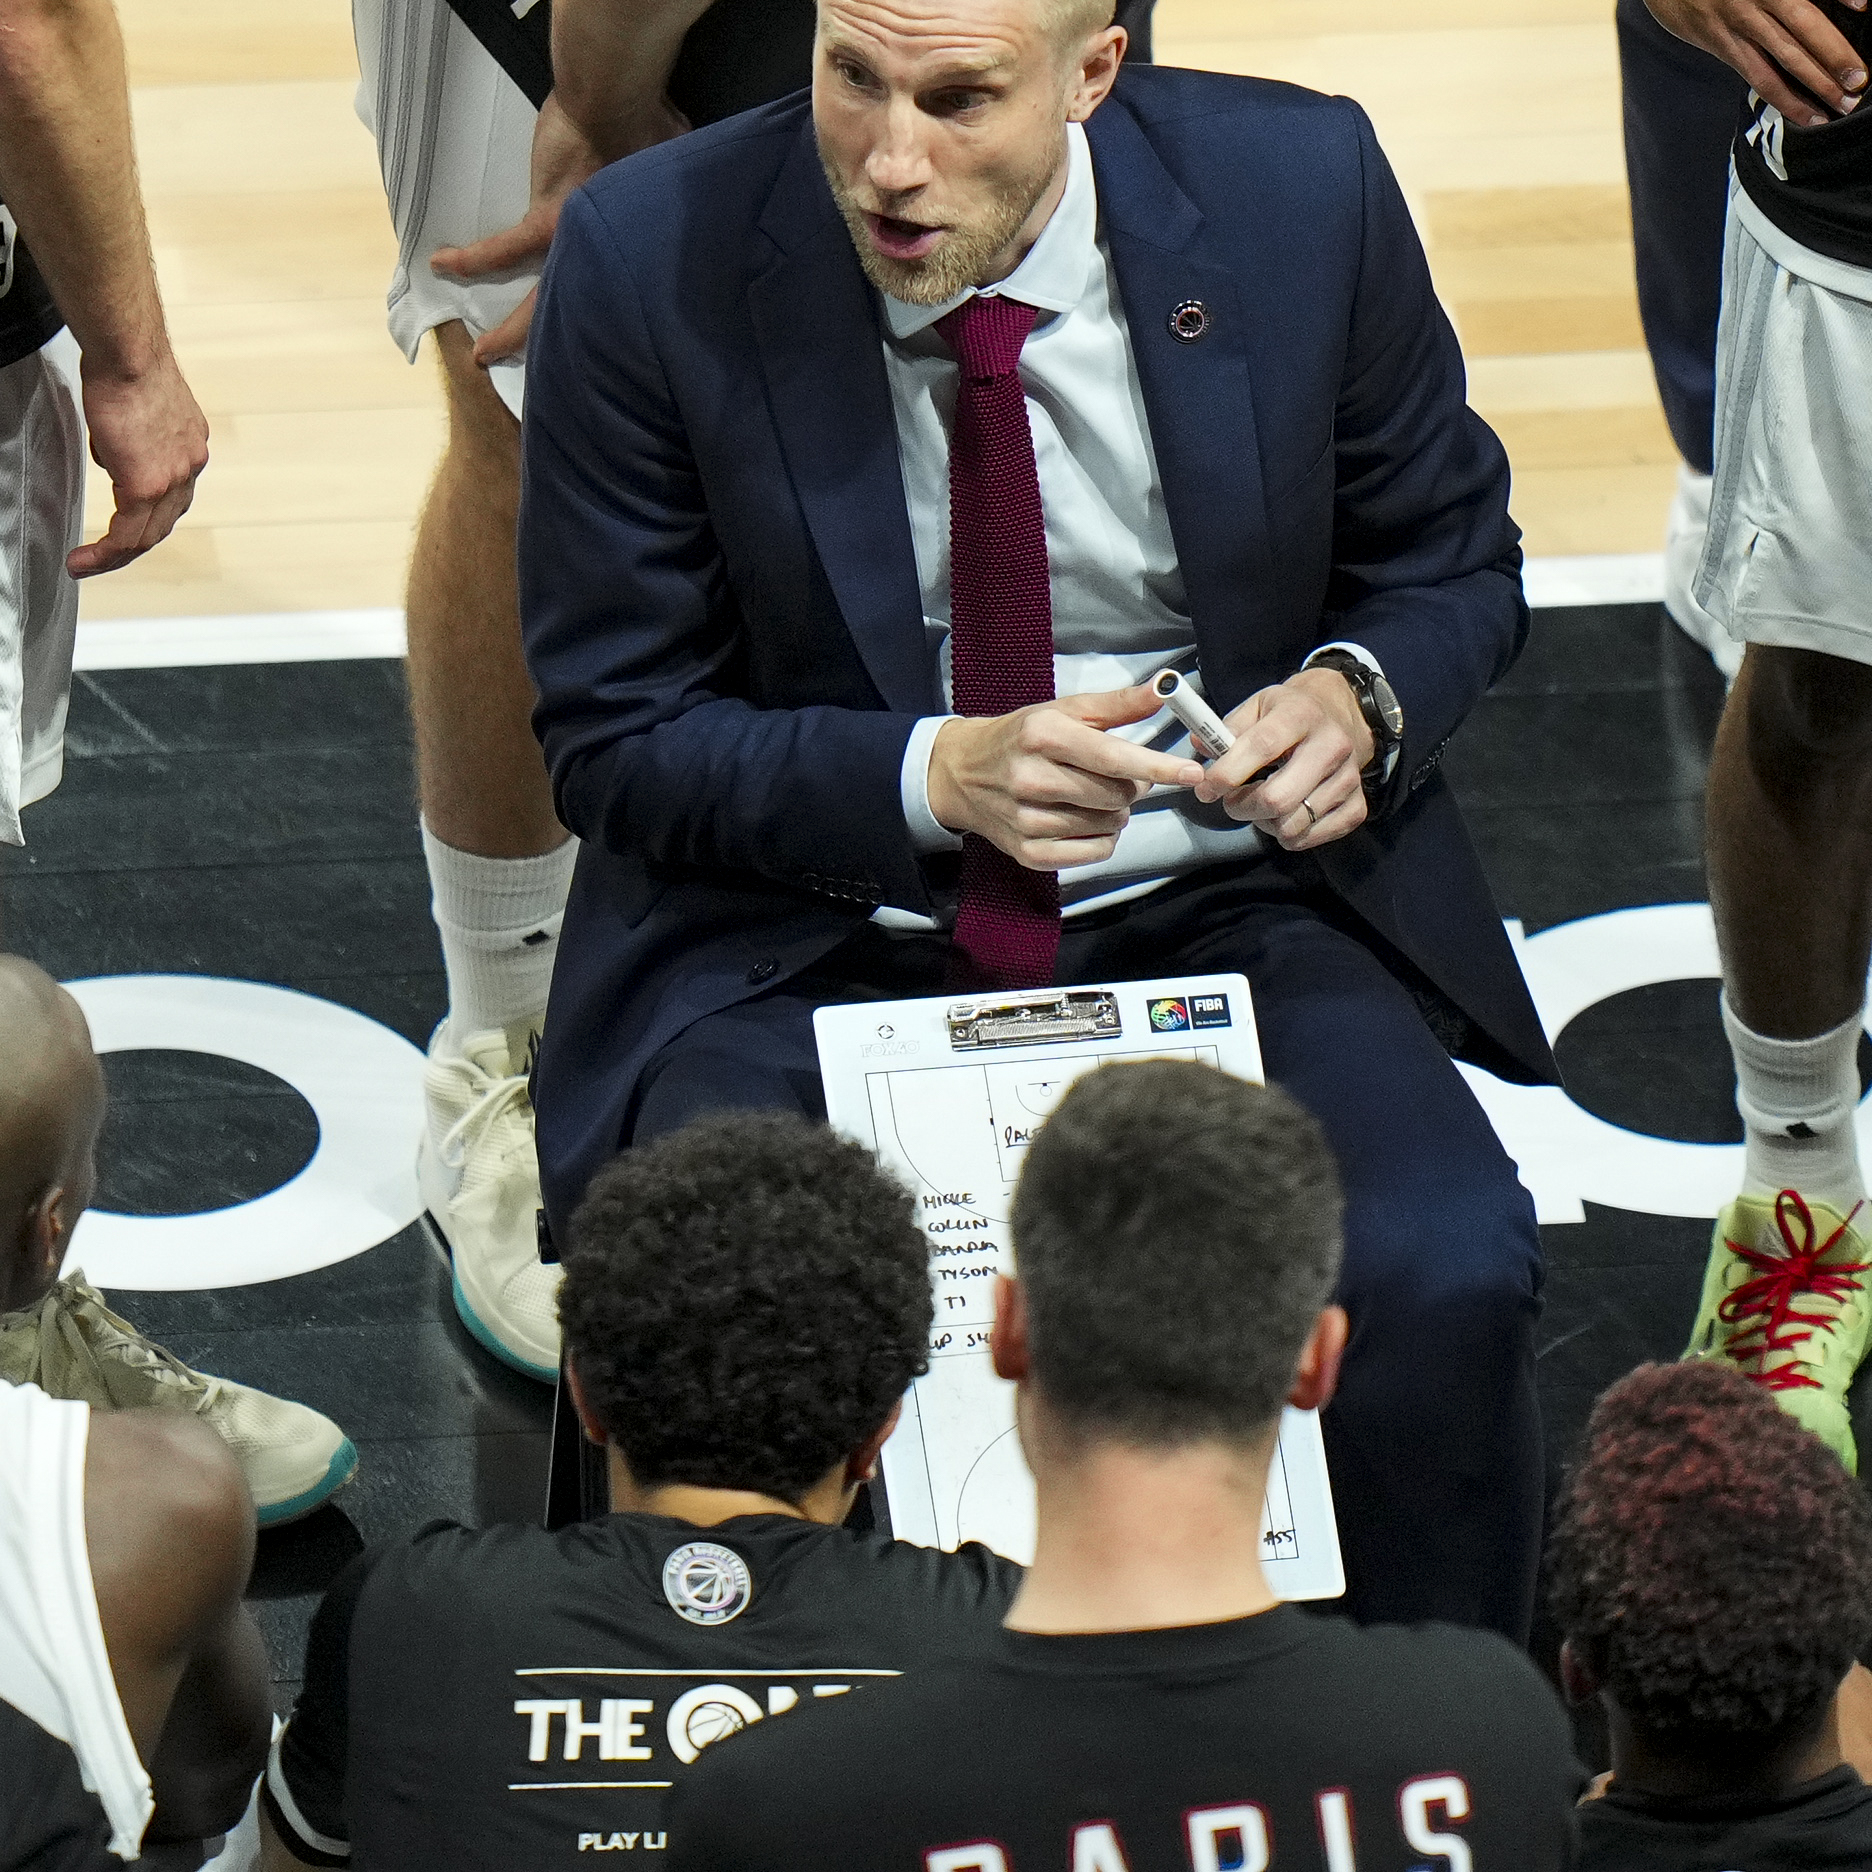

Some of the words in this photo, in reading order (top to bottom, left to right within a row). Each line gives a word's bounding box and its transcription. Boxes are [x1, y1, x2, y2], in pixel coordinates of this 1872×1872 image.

[1194, 997, 1224, 1012] FIBA
[937, 1266, 998, 1280] TYSON
[514, 1698, 654, 1762] THE
[577, 1832, 641, 1852] PLAY
[643, 1831, 668, 1851] LI
